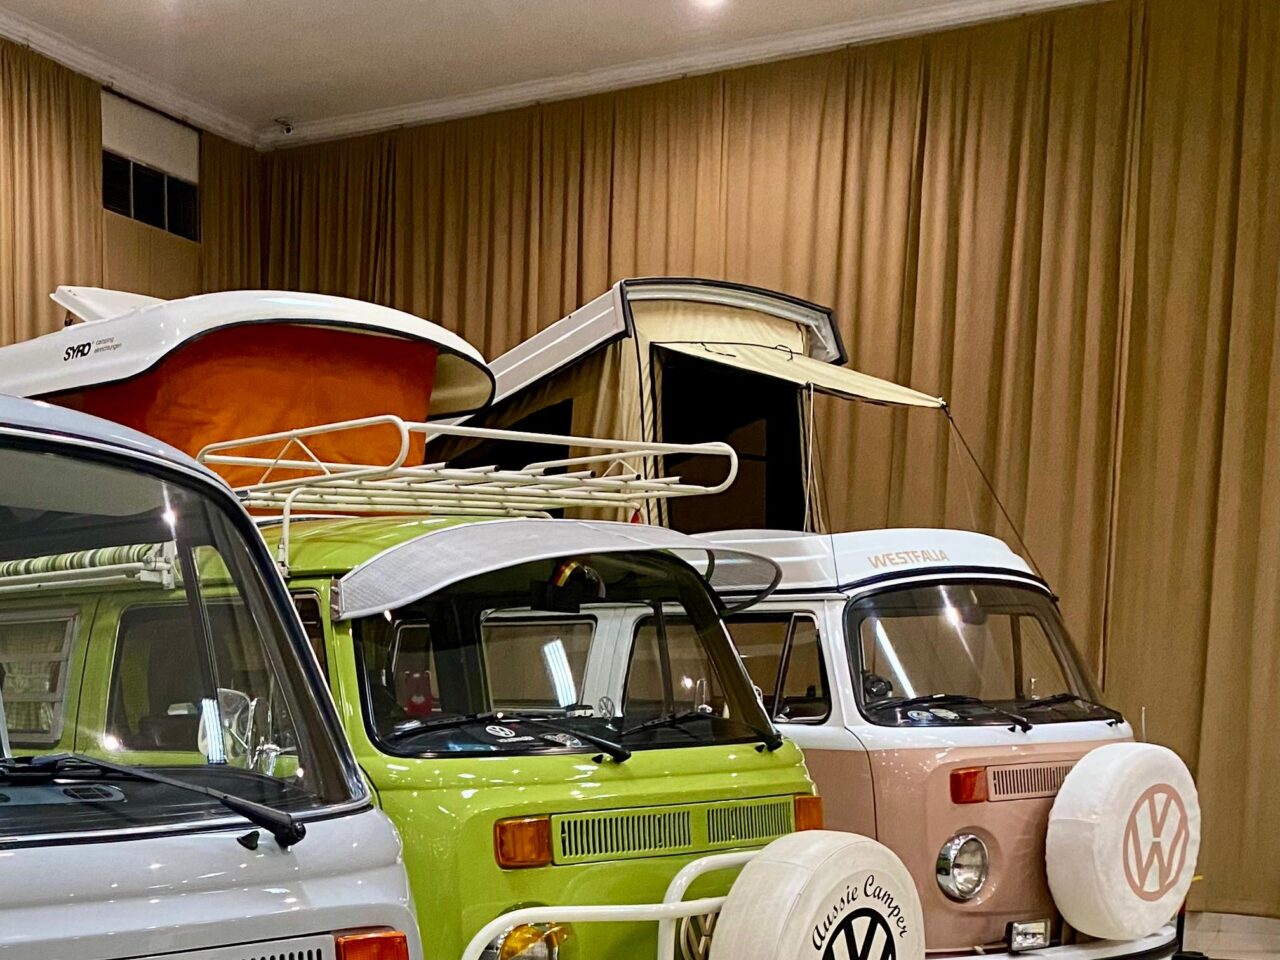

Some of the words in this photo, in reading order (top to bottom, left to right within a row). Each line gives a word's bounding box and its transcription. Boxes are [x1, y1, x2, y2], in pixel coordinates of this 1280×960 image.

[64, 342, 91, 361] SYRO
[867, 549, 950, 568] WESTFALIA
[1123, 783, 1190, 901] VW
[812, 885, 858, 952] Aussie
[863, 874, 909, 938] Camper
